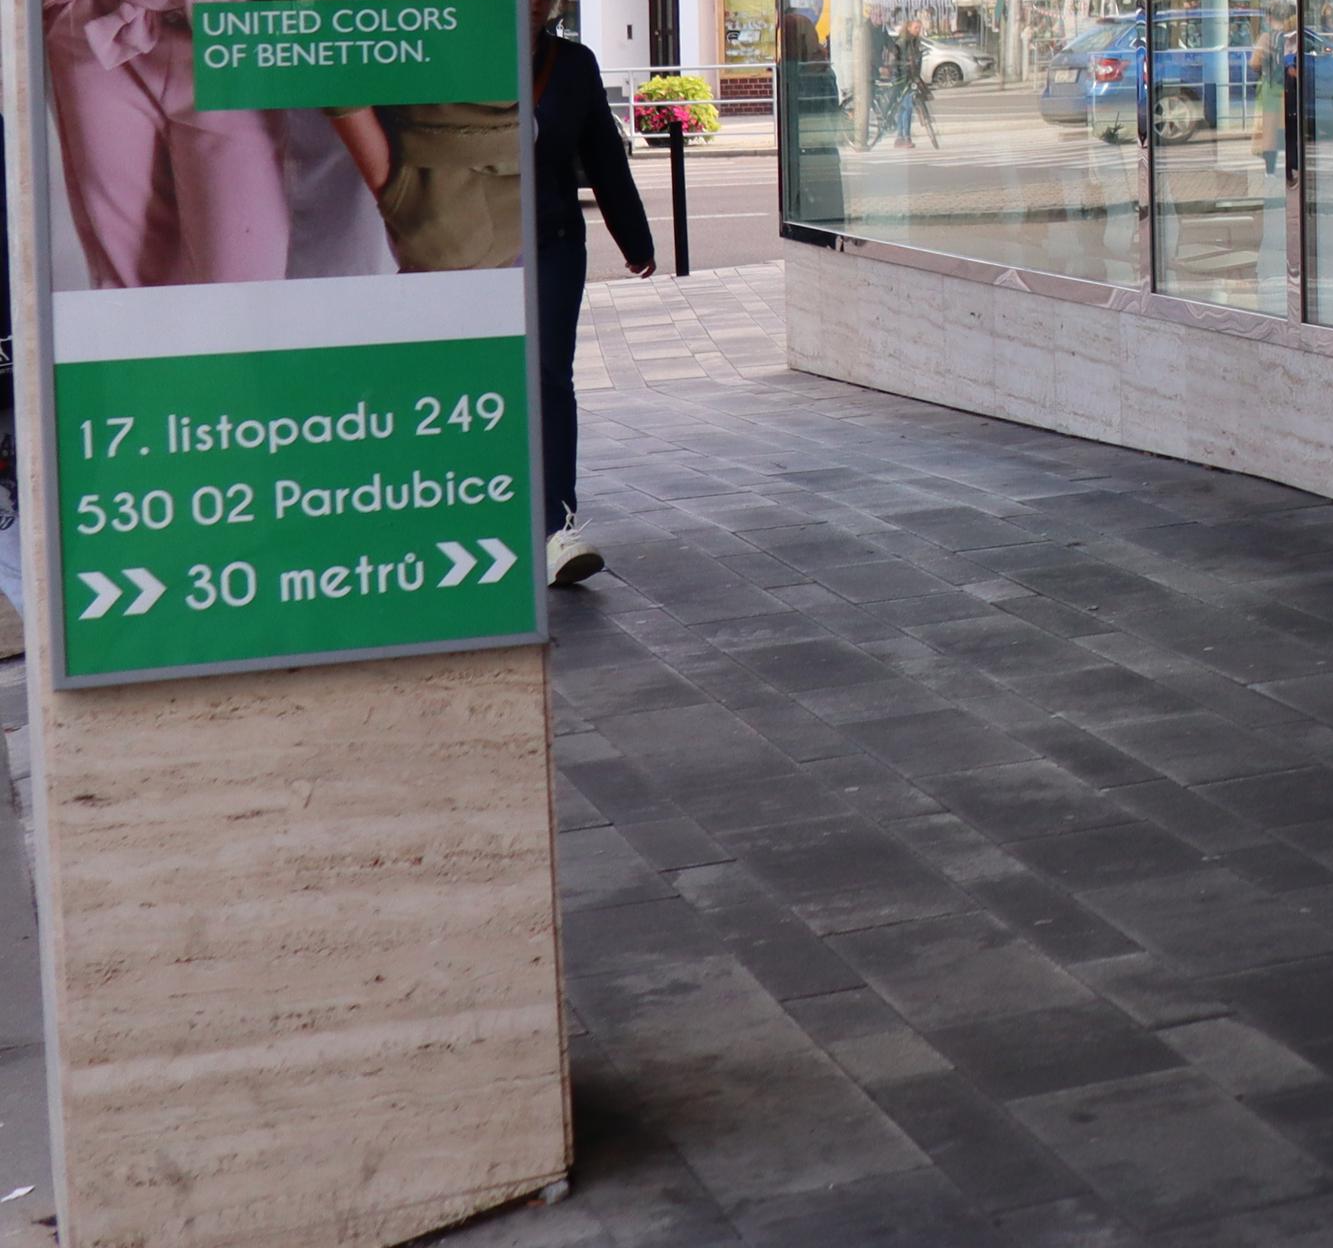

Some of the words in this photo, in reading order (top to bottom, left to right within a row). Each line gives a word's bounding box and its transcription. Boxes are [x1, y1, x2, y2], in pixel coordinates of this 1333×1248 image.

[203, 10, 320, 37] UNITED
[332, 7, 458, 33] COLORS
[204, 44, 248, 68] OF
[258, 41, 431, 68] BENETTON.
[81, 417, 150, 459] 17.
[168, 400, 394, 455] listopadu
[415, 392, 505, 436] 249
[76, 490, 173, 535] 530
[192, 483, 256, 526] 02
[276, 471, 515, 520] Pardubice
[185, 561, 257, 611] 30
[280, 552, 425, 602] metrů
